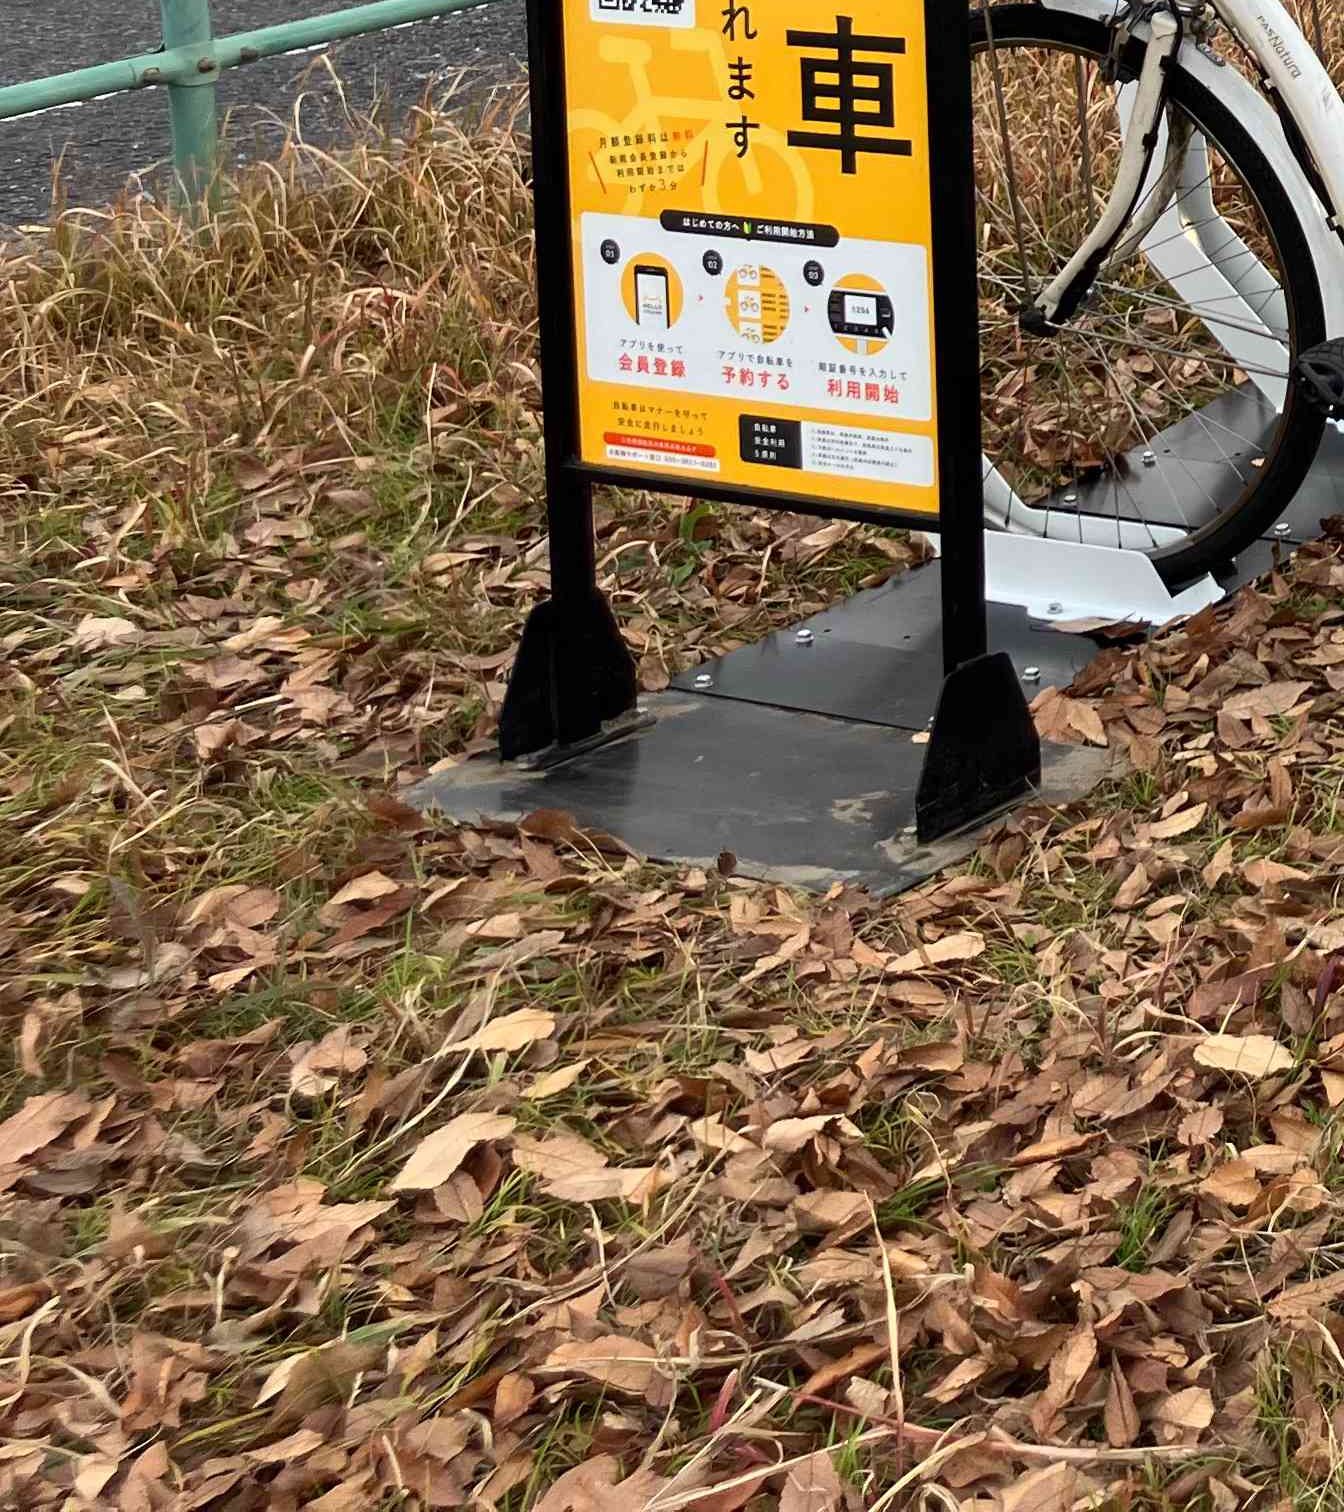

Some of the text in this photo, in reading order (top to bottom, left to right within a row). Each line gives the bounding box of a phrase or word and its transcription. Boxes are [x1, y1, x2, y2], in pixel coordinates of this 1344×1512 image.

[682, 216, 741, 232] はじめての方へ
[618, 353, 686, 378] 会員登録
[721, 366, 791, 391] 予約する
[827, 378, 900, 404] 利用開始
